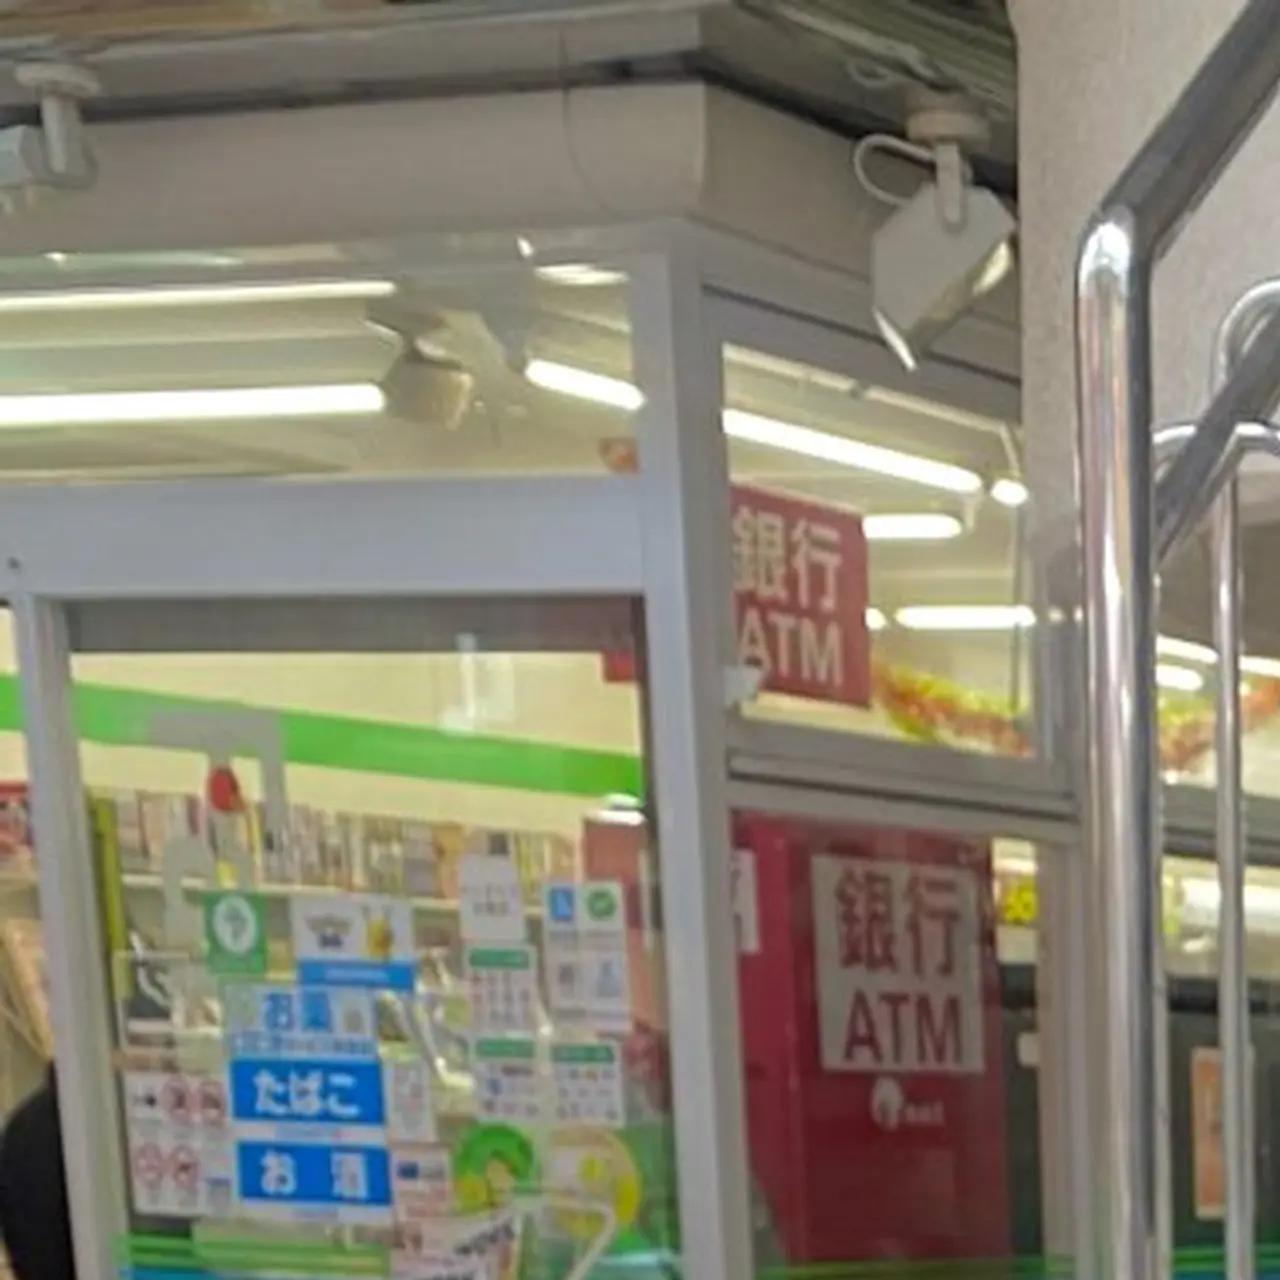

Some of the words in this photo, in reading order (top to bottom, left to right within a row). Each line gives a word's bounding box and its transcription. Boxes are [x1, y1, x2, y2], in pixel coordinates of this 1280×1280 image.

[732, 505, 842, 611] 銀行
[738, 606, 843, 687] ATM
[835, 865, 960, 977] 銀行
[842, 989, 963, 1064] ATM
[253, 1069, 360, 1117] たばこ
